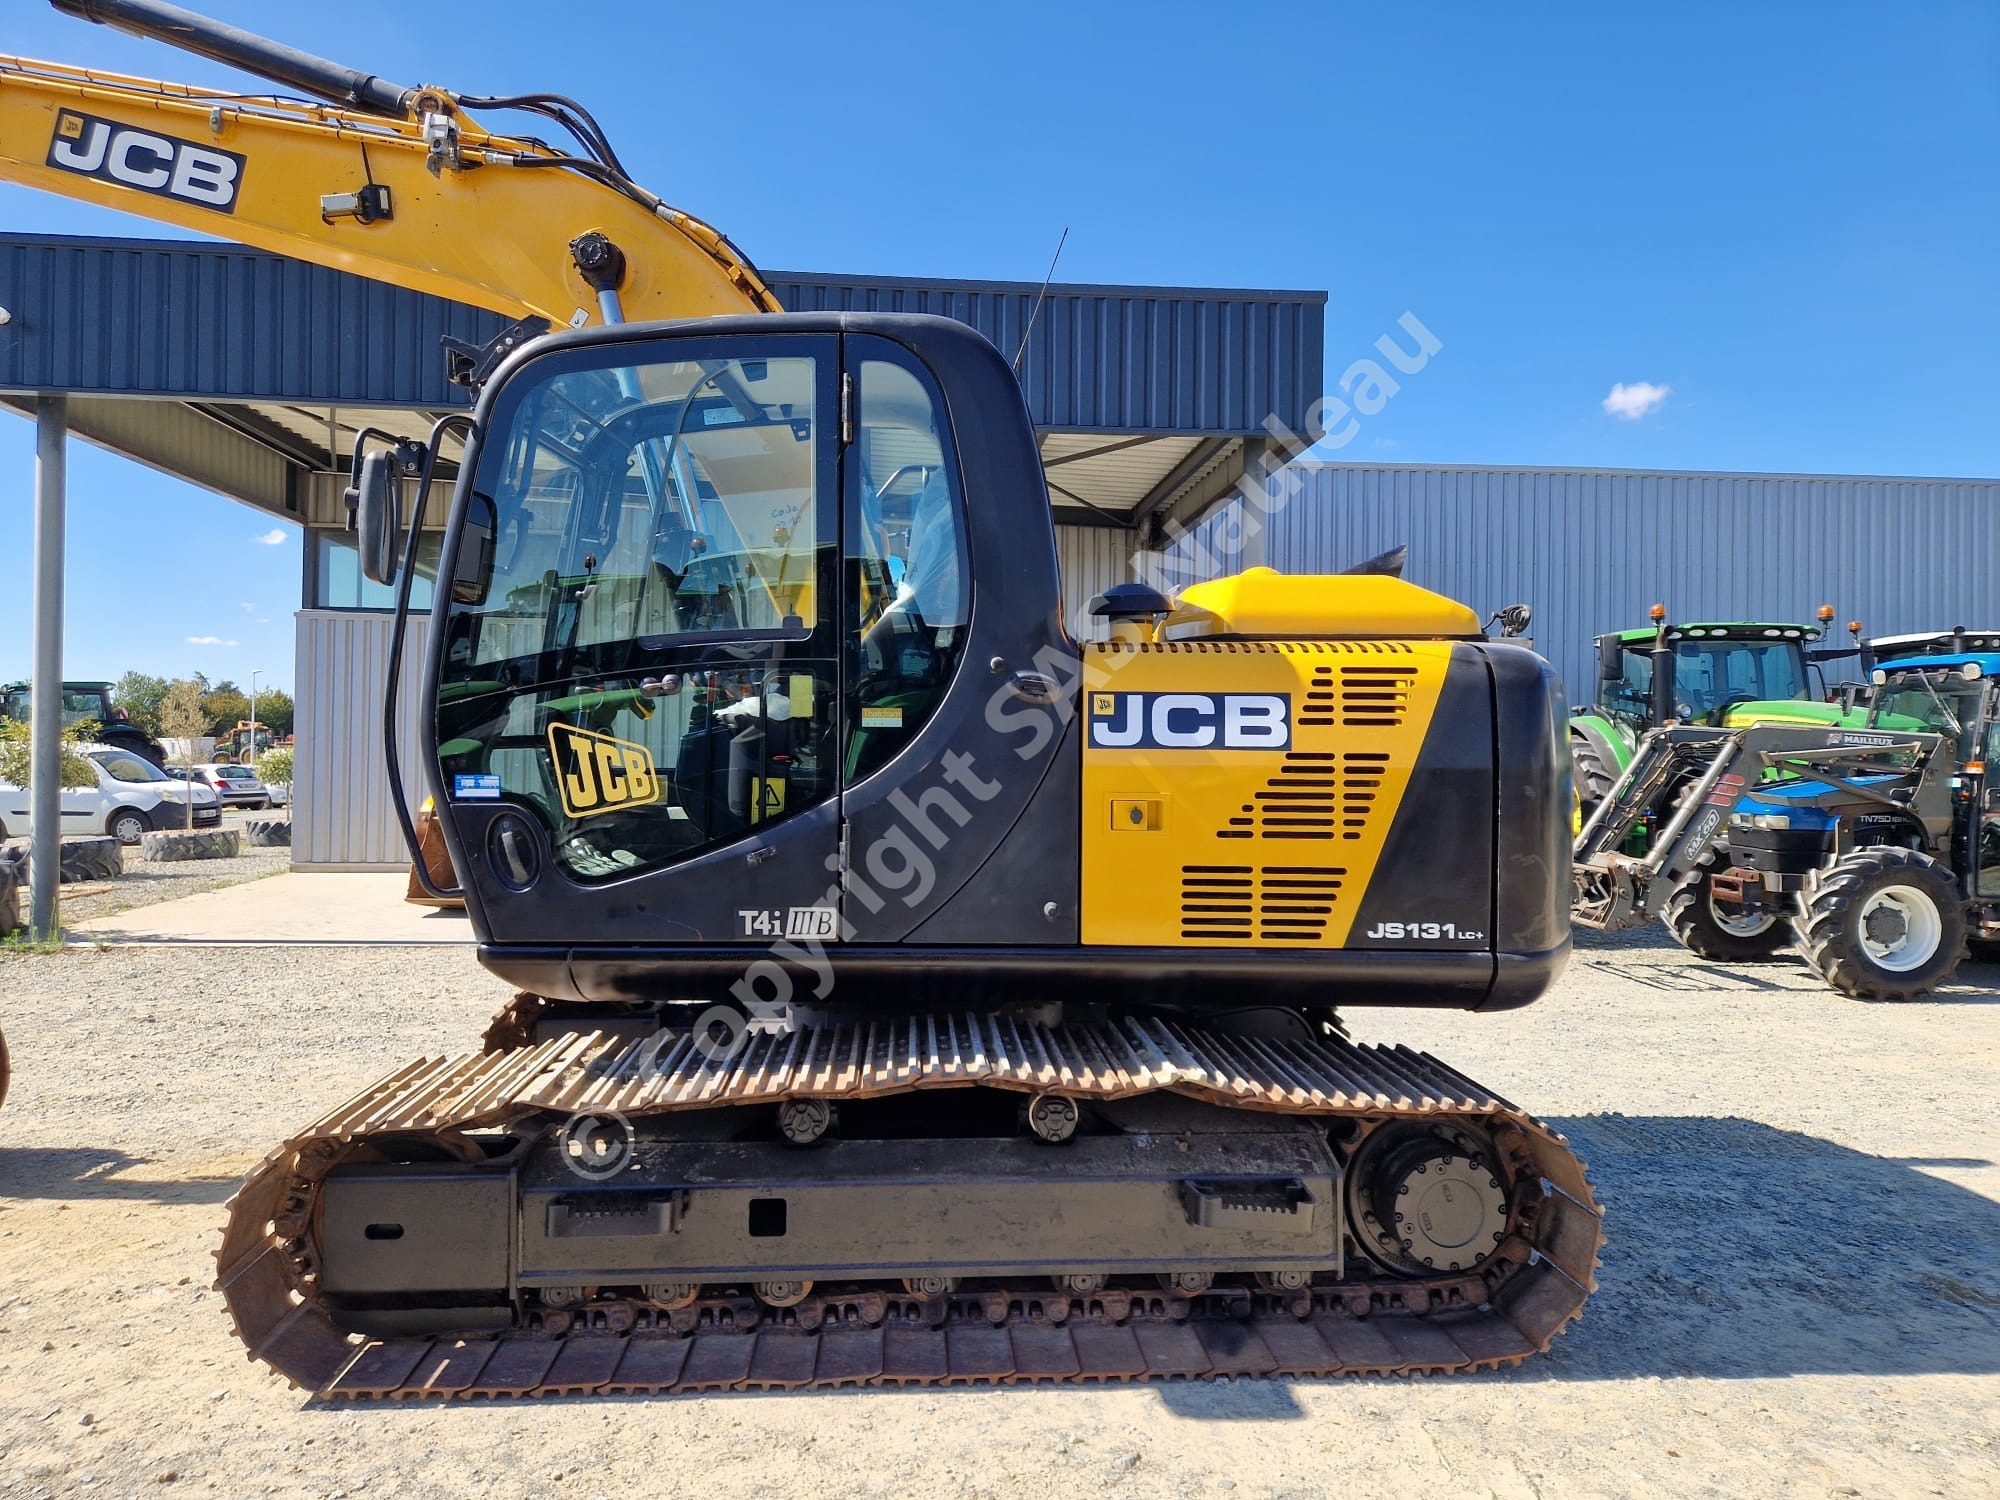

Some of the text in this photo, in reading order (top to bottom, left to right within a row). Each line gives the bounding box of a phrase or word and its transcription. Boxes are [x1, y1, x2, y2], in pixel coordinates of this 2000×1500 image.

[55, 122, 238, 205] JCB
[1094, 694, 1288, 747] JCB
[1844, 735, 1894, 746] MAILLEUX
[566, 734, 652, 808] JCB
[739, 910, 783, 936] T4i
[1367, 922, 1484, 940] JS131 LC+
